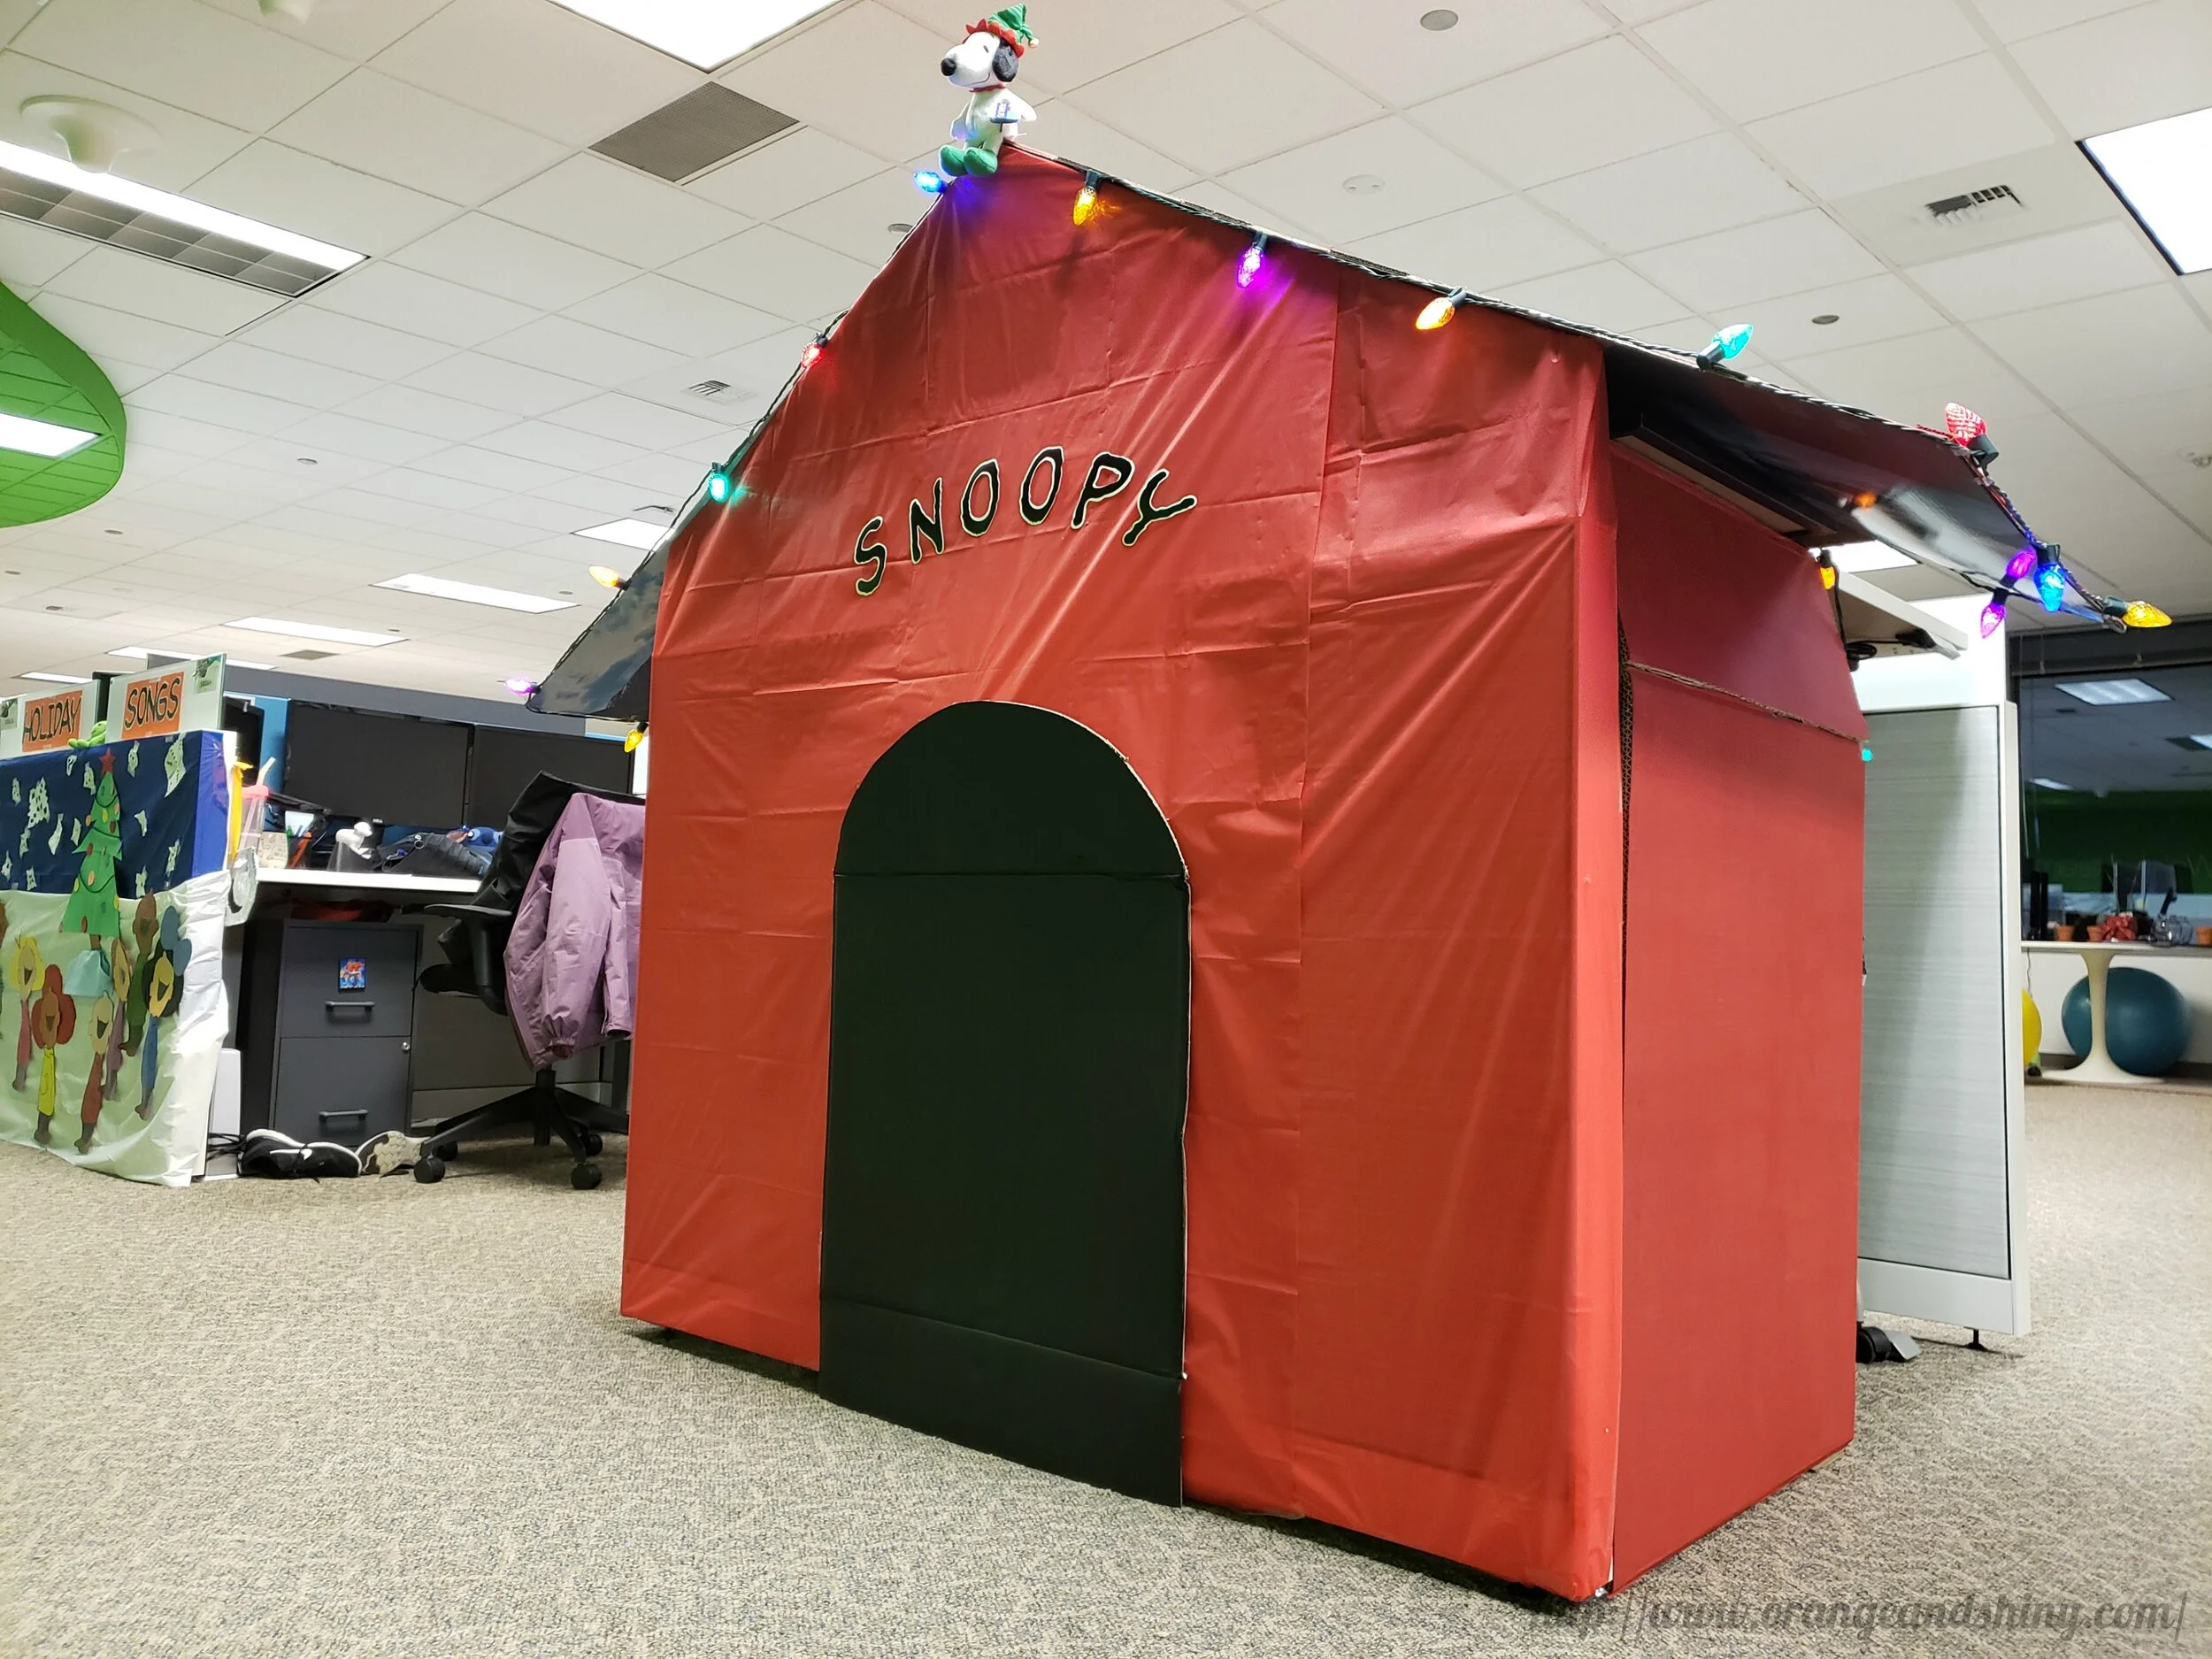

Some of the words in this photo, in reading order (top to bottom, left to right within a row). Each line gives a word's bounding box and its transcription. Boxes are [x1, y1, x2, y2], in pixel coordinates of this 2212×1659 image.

[854, 445, 1198, 596] SNOOPY
[22, 697, 81, 743] HOLIDAY
[124, 677, 180, 729] SONGS
